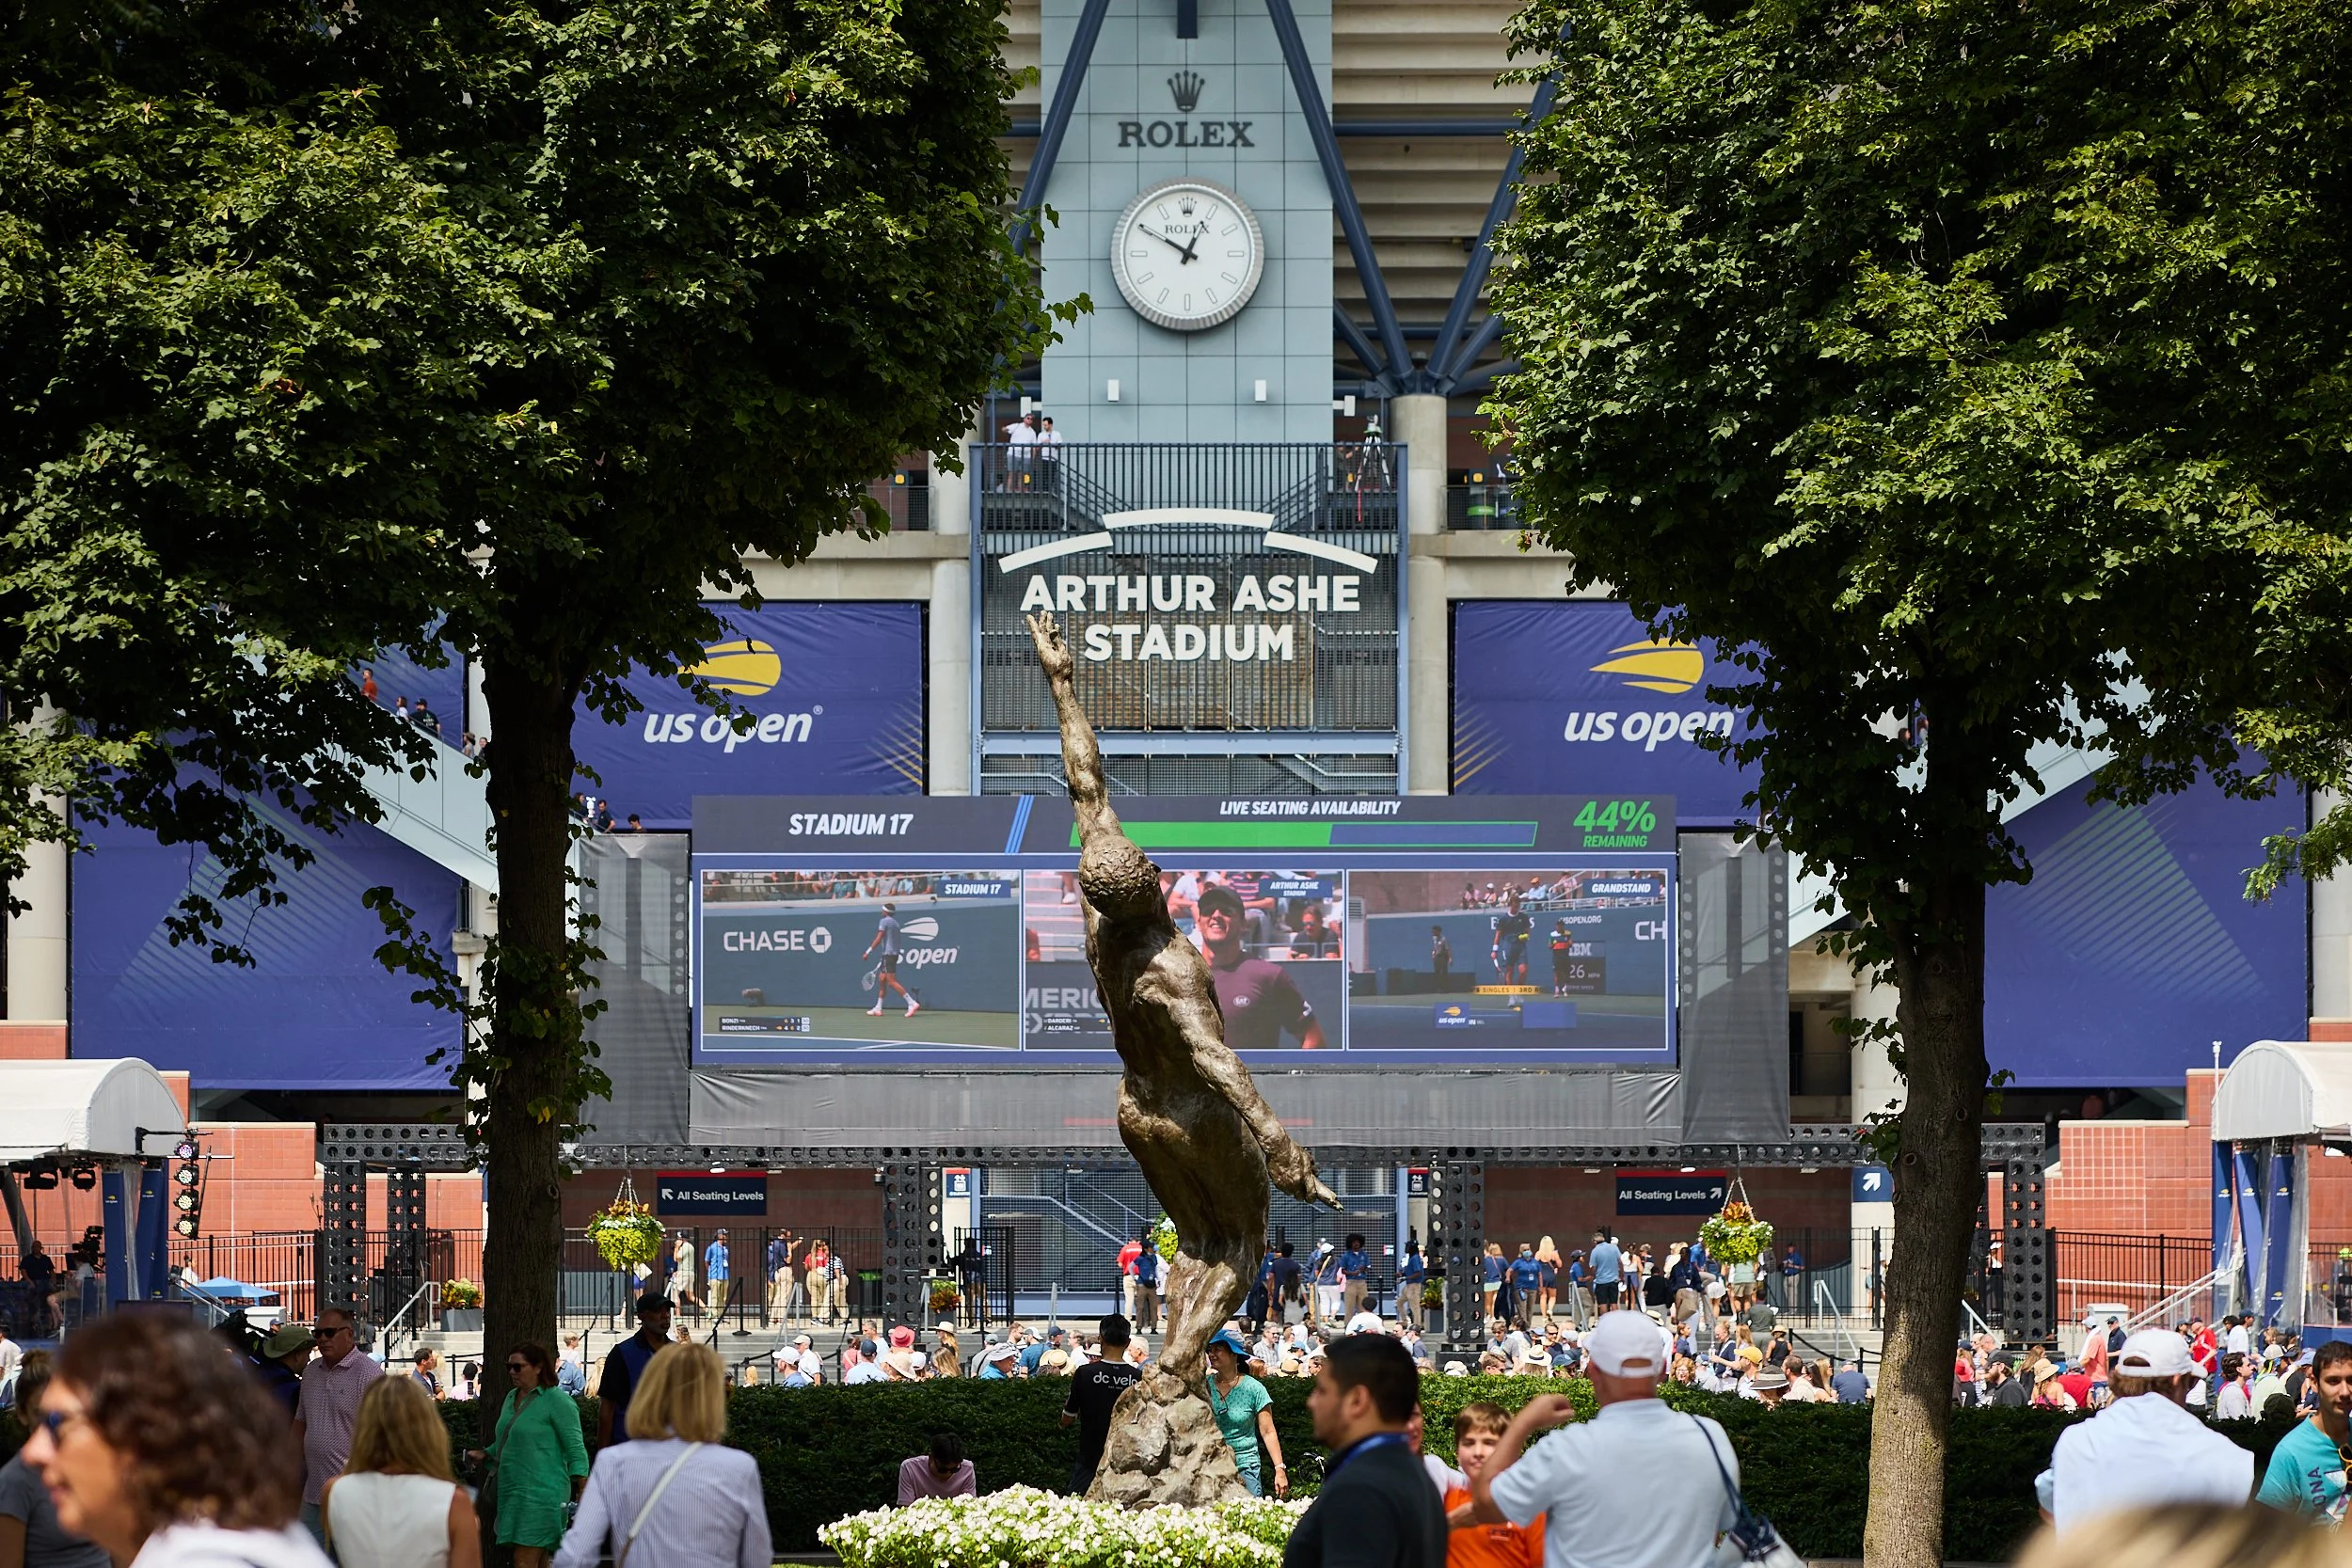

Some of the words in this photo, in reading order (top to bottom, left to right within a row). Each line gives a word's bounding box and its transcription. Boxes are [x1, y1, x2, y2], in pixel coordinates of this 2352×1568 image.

[1118, 120, 1255, 148] ROLEX
[1020, 575, 1216, 612] ARTHUR
[1232, 575, 1360, 612] ASHE
[1084, 625, 1294, 661] STADIUM
[643, 713, 696, 743] us
[1564, 711, 1618, 742] us
[1620, 711, 1735, 752] open
[1219, 801, 1249, 816] LIVE
[1251, 801, 1307, 816] SEATING
[1310, 801, 1402, 816] AVAILABILITY
[1573, 800, 1657, 832] 44%
[788, 814, 886, 835] STADIUM
[889, 814, 914, 835] 17
[1583, 835, 1648, 847] REMAINING
[945, 884, 988, 895] STADIUM
[991, 884, 1002, 895] 17
[1270, 881, 1298, 890] ARTHUR
[1300, 881, 1319, 890] ASHE
[1591, 883, 1651, 894] GRANDSTAND
[723, 930, 805, 952] CHASE
[1635, 921, 1666, 941] CH
[905, 948, 958, 970] open
[677, 1191, 691, 1200] All
[692, 1191, 730, 1203] Seating
[733, 1191, 764, 1200] Levels
[1619, 1190, 1632, 1199] All
[1634, 1190, 1672, 1202] Seating
[1675, 1190, 1707, 1199] Levels
[1093, 1371, 1110, 1384] dc
